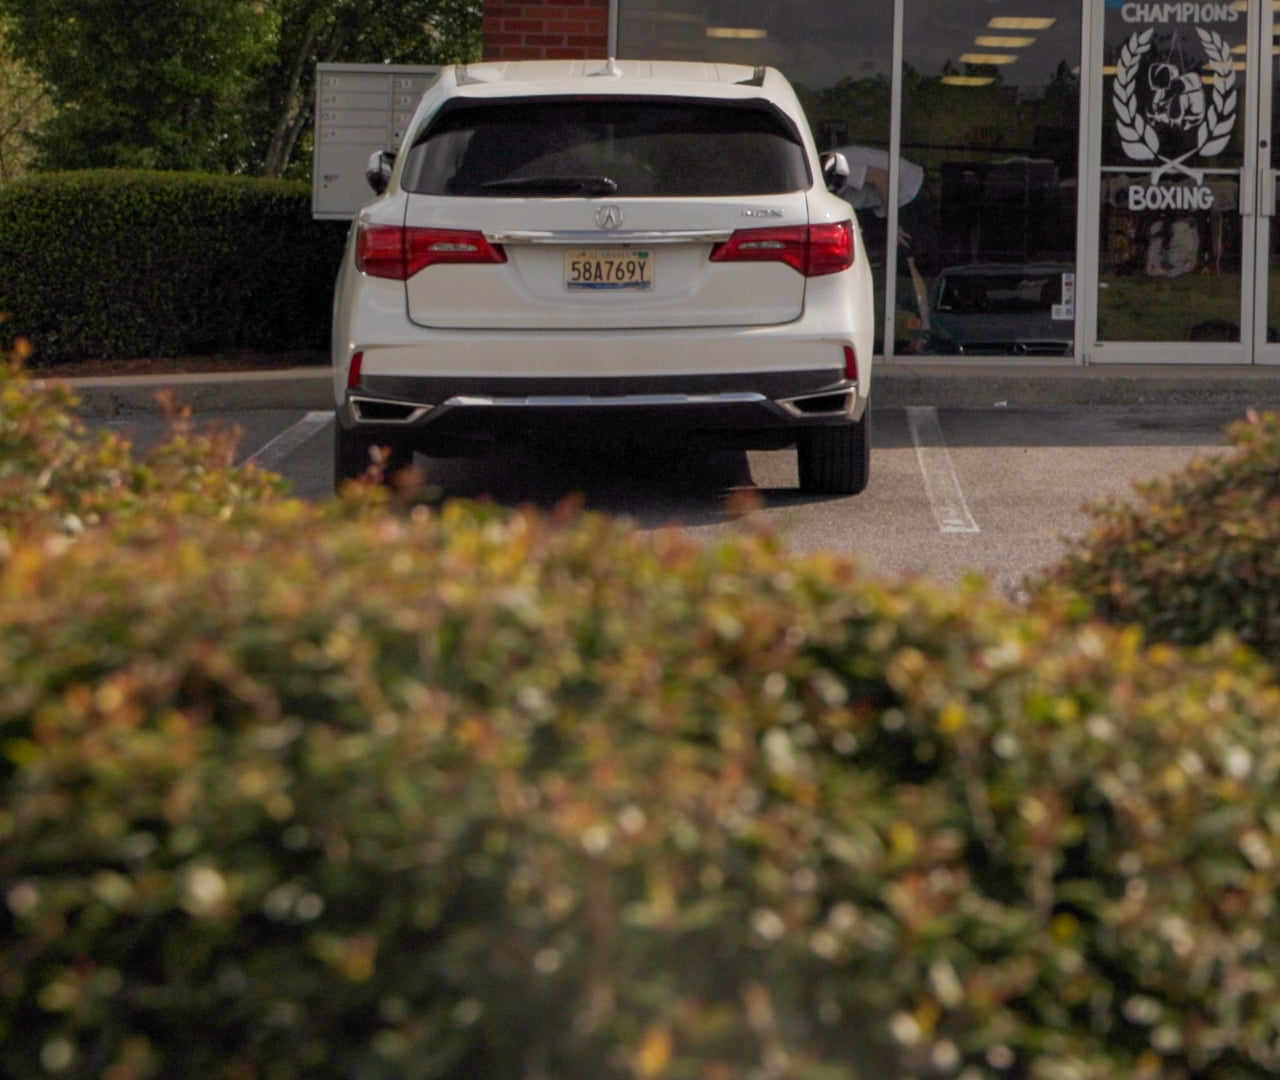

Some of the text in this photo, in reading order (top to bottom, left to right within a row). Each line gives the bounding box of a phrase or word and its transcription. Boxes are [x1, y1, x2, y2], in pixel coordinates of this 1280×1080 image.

[1121, 2, 1239, 23] CHAMPIONS
[1128, 185, 1215, 211] BOXING
[571, 260, 646, 281] 58A769Y
